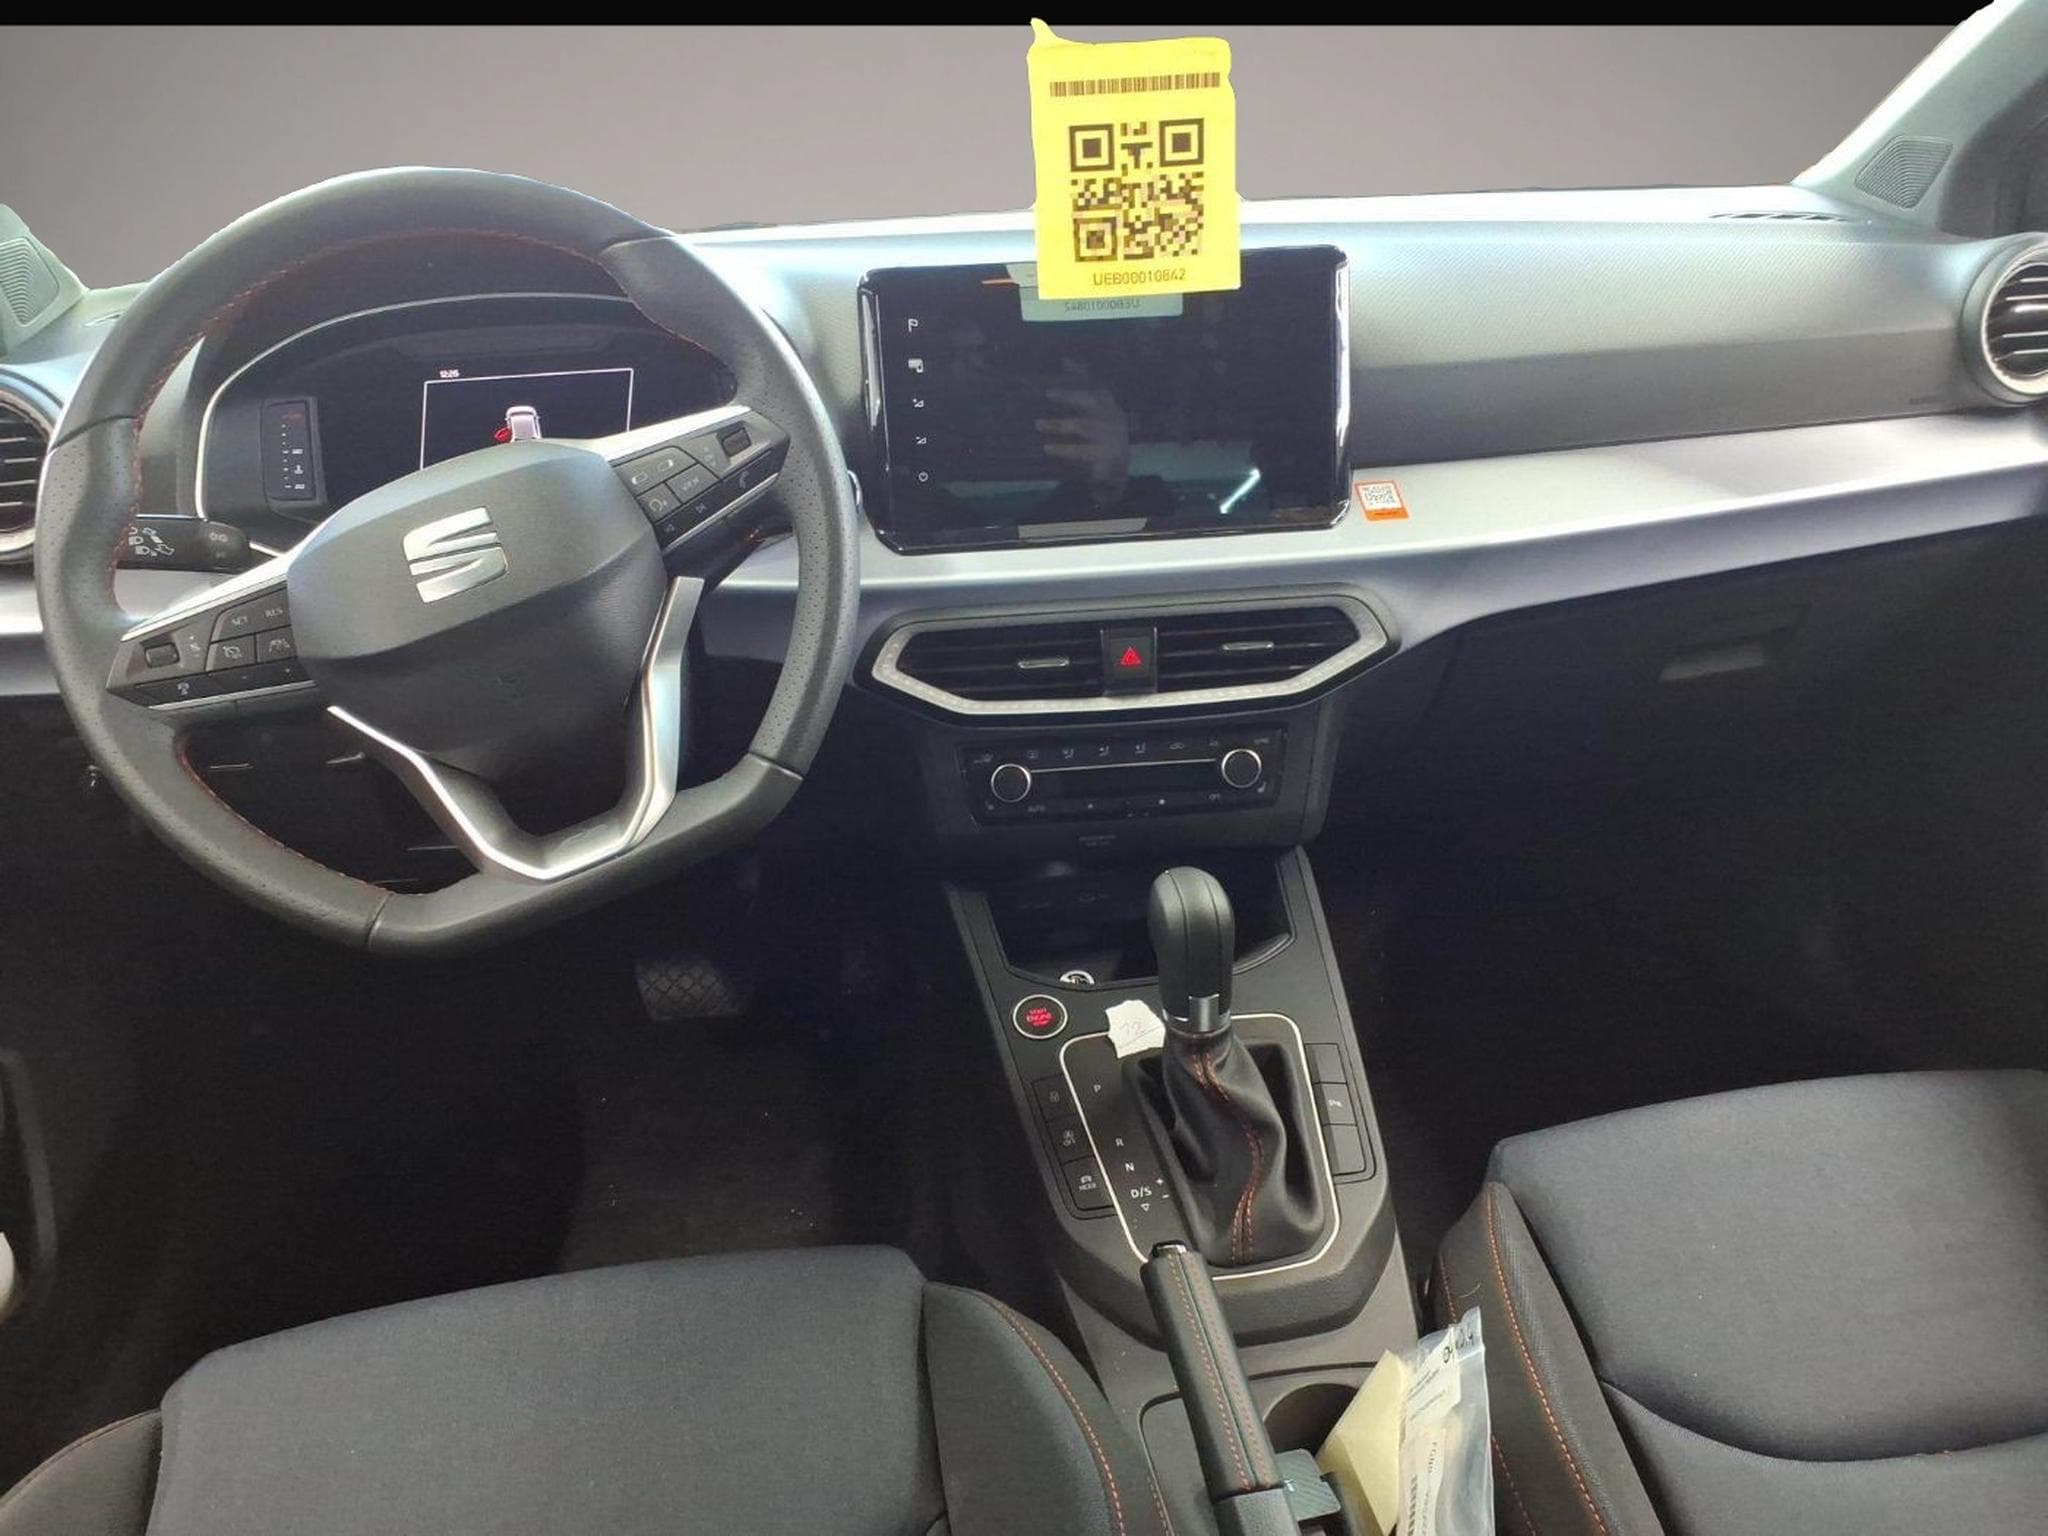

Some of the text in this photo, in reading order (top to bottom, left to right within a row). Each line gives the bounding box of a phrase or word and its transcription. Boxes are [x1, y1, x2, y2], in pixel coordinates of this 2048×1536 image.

[1093, 268, 1186, 286] UEB00010842
[1115, 1137, 1124, 1147] R
[1125, 1162, 1135, 1172] N
[1130, 1186, 1153, 1199] D/S
